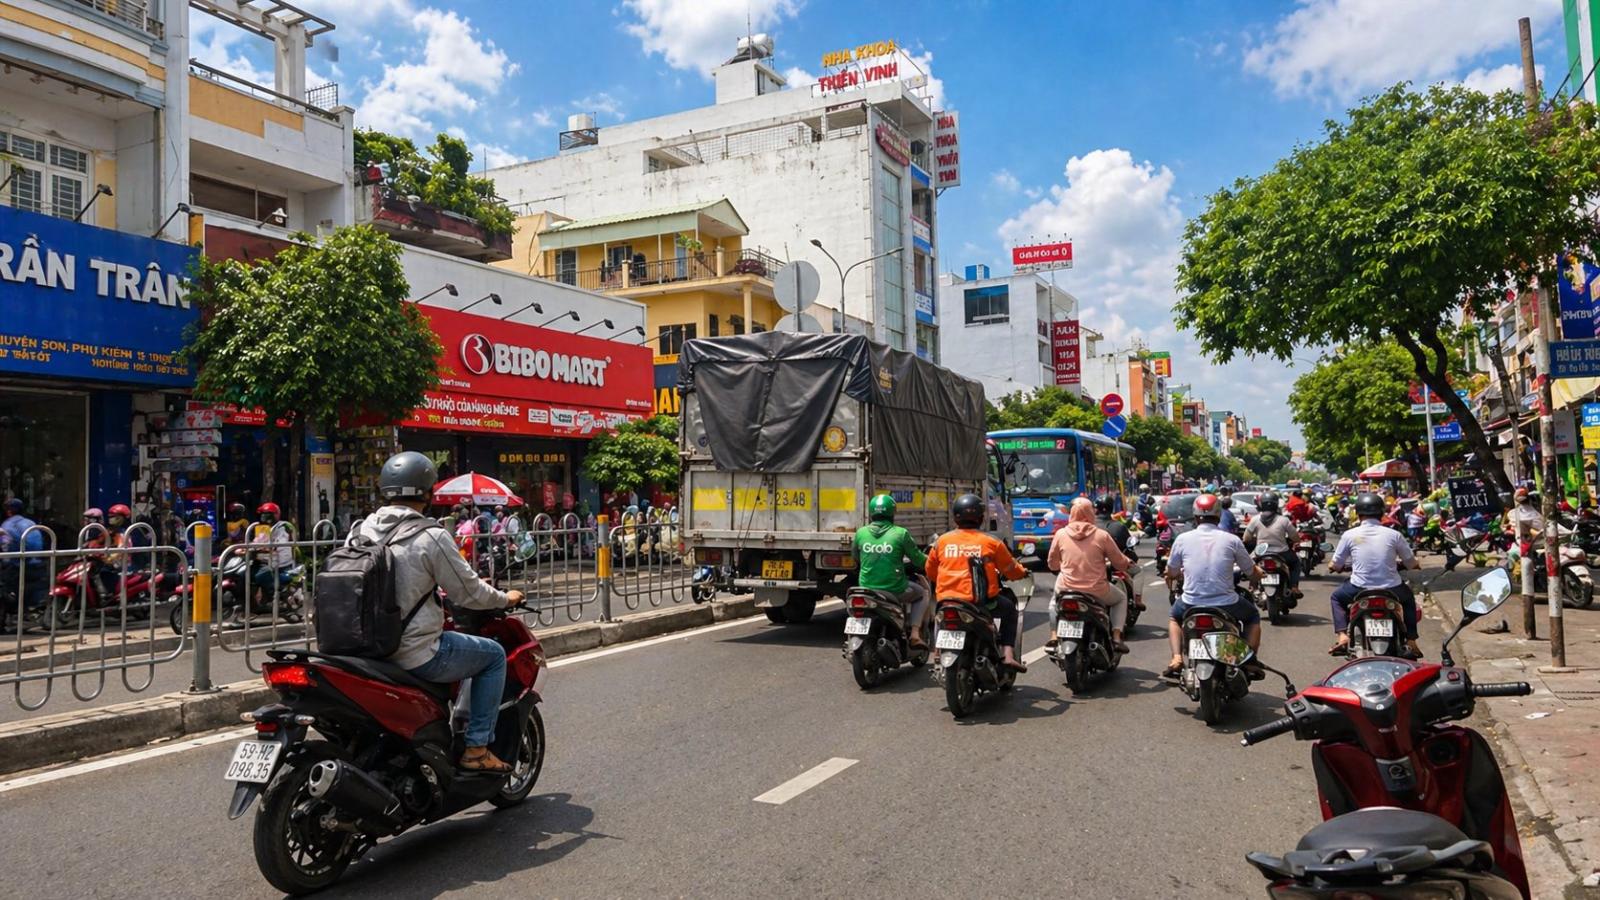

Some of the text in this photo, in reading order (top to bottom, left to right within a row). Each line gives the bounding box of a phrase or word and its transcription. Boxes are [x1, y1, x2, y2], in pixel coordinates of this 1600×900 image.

[856, 40, 896, 61] KHOA
[864, 62, 898, 82] VINH
[495, 343, 607, 387] BIBO MART
